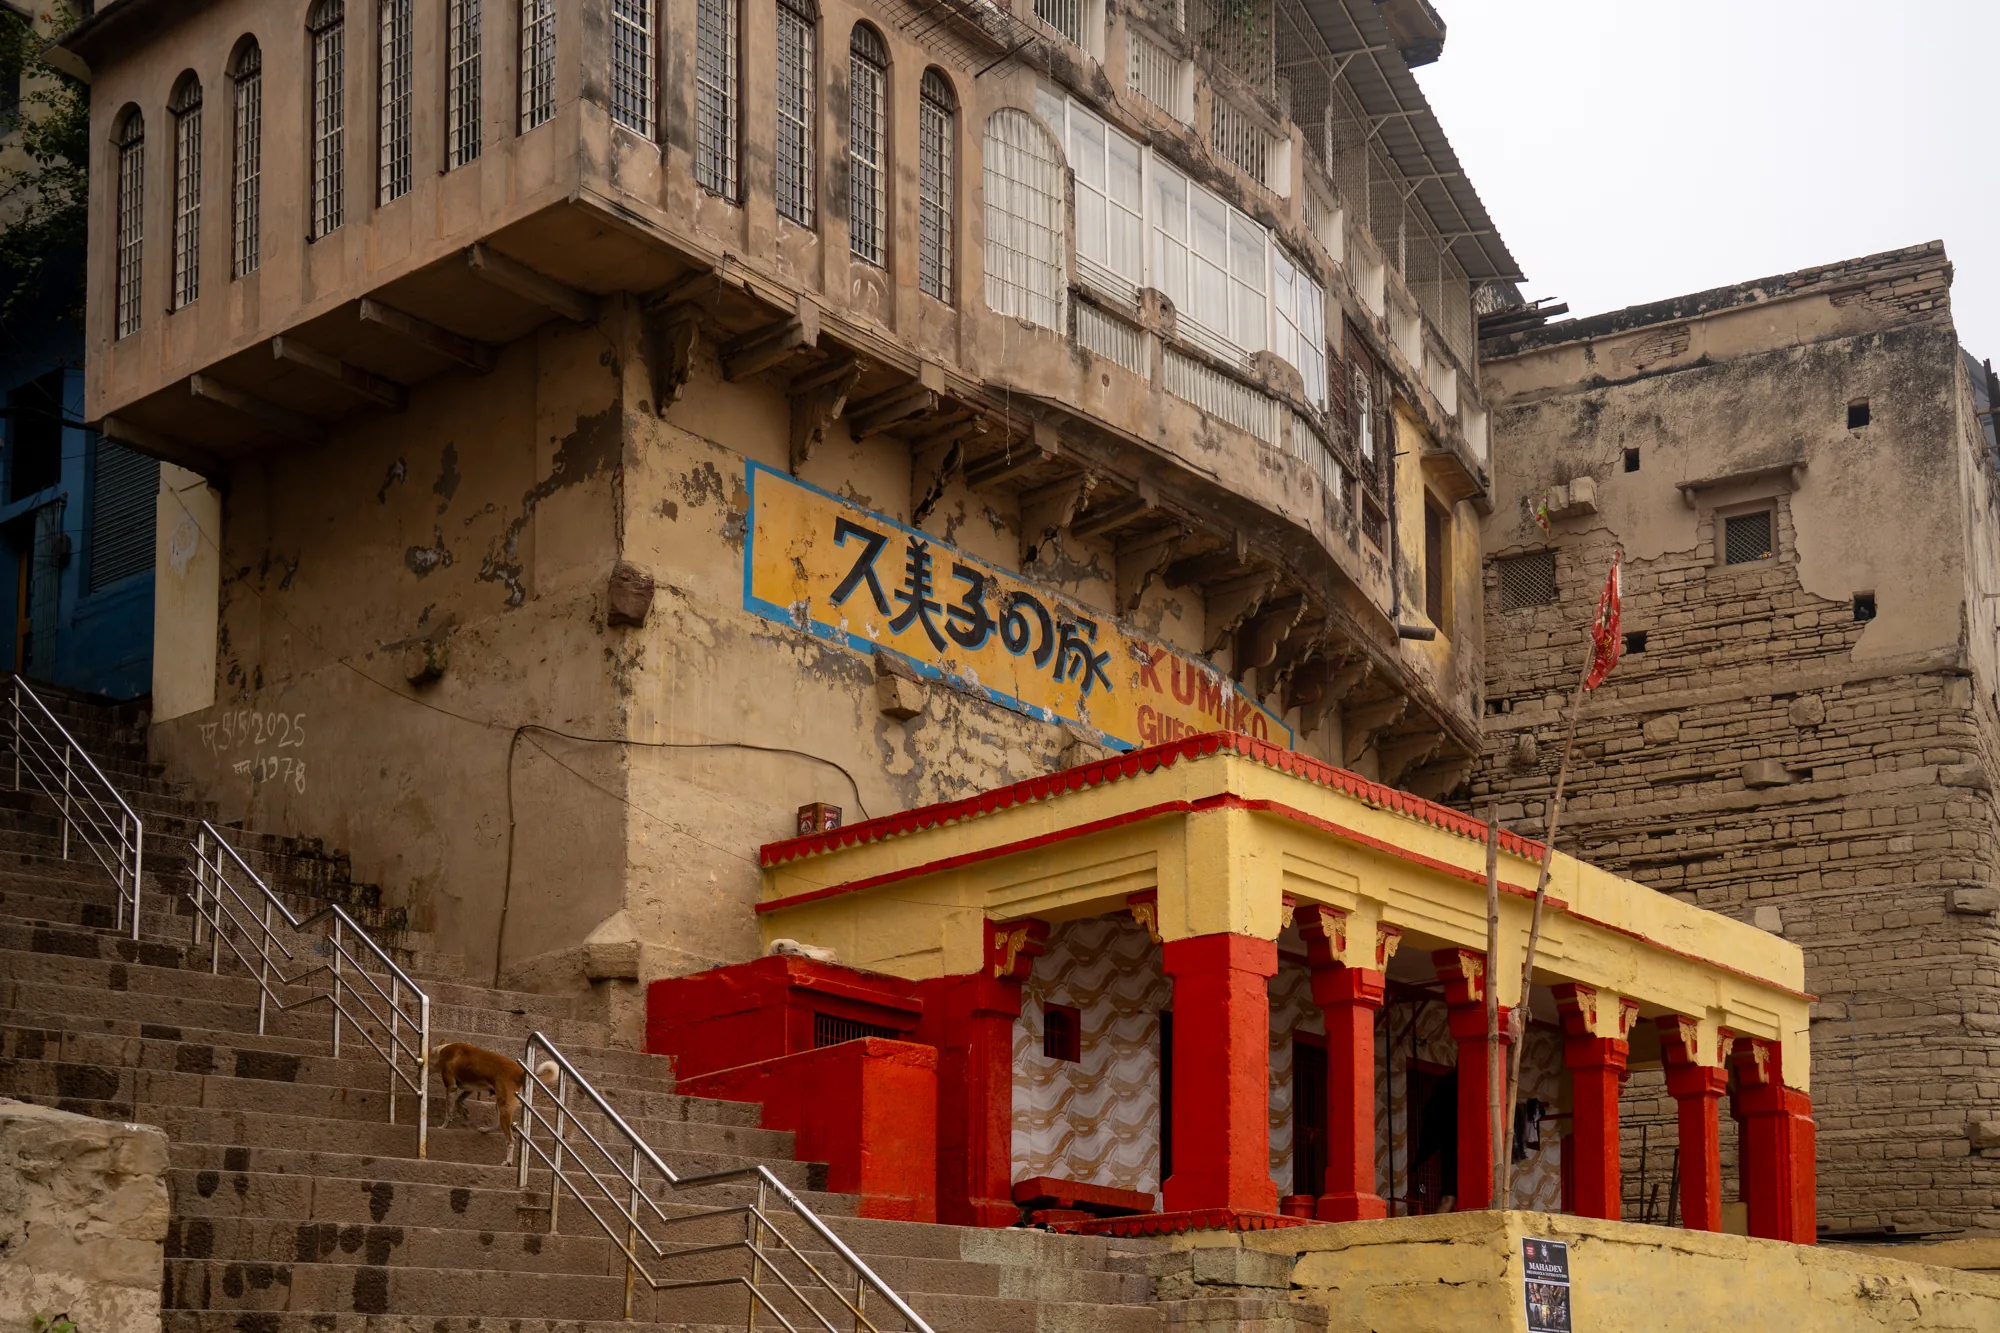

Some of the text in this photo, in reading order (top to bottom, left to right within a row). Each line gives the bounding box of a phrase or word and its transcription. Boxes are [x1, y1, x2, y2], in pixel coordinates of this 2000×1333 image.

[1140, 642, 1268, 741] KUMIKO
[1137, 704, 1204, 745] GUE
[1528, 1262, 1563, 1273] MAHADEV
